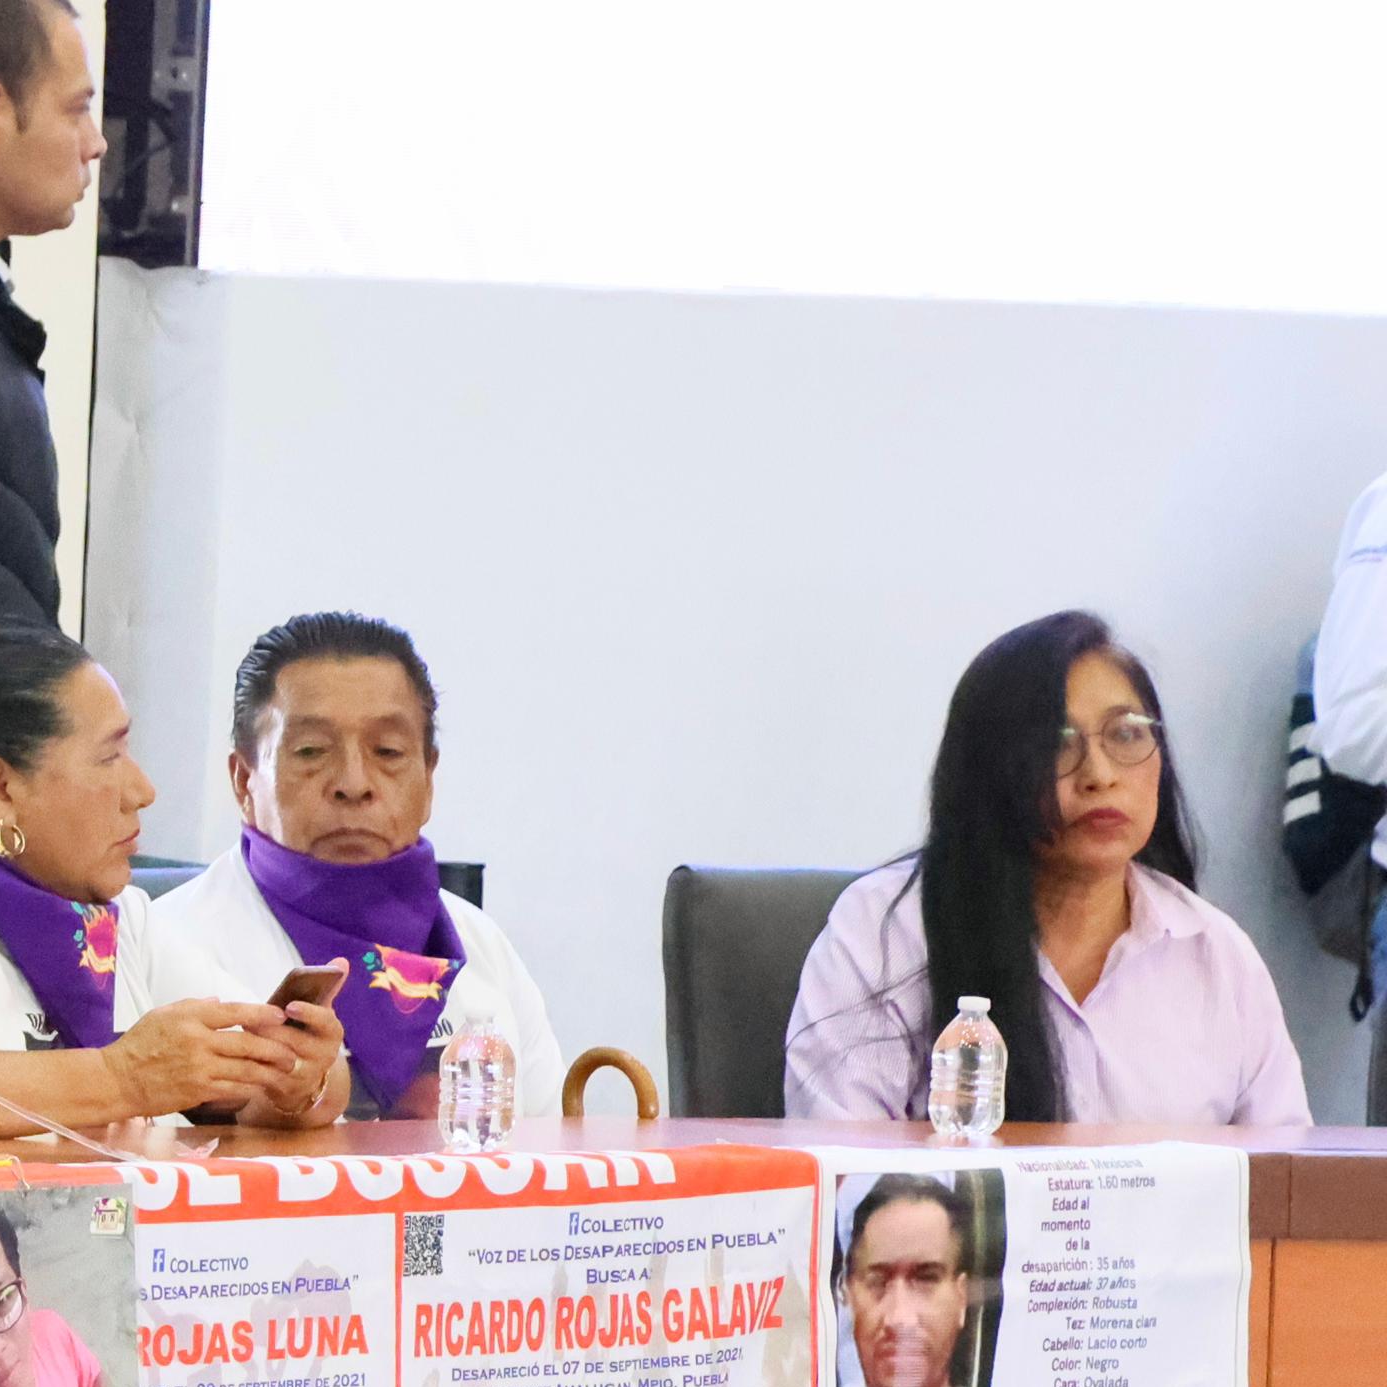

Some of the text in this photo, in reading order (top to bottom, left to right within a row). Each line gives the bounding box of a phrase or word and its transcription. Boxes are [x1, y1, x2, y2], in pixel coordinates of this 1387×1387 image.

[1048, 1178, 1093, 1191] Estatura:
[1121, 1176, 1155, 1188] metros
[1052, 1198, 1078, 1211] Edad
[1041, 1218, 1090, 1231] momento
[531, 1248, 560, 1261] LOS
[564, 1240, 684, 1262] DESAPARECIDOS
[711, 1229, 785, 1249] PUEBLA"
[1112, 1256, 1135, 1270] años
[587, 1269, 635, 1284] BUSCA
[151, 1282, 268, 1301] DESAPARECIDOS
[1030, 1280, 1056, 1292] Edad
[1028, 1296, 1137, 1314] Complexión: Robusta
[415, 1298, 545, 1357] RICARDO
[555, 1288, 652, 1350] ROJAS
[1066, 1316, 1133, 1330] Tez: Morena
[139, 1315, 368, 1367] ROJAS LUNA
[1043, 1336, 1083, 1352] Cabello:
[1088, 1336, 1117, 1350] Lacio
[452, 1356, 690, 1381] DESAPARECIÓ SEPTIEMBRE
[1052, 1357, 1119, 1373] Color: Negro
[333, 1373, 365, 1387] 2021
